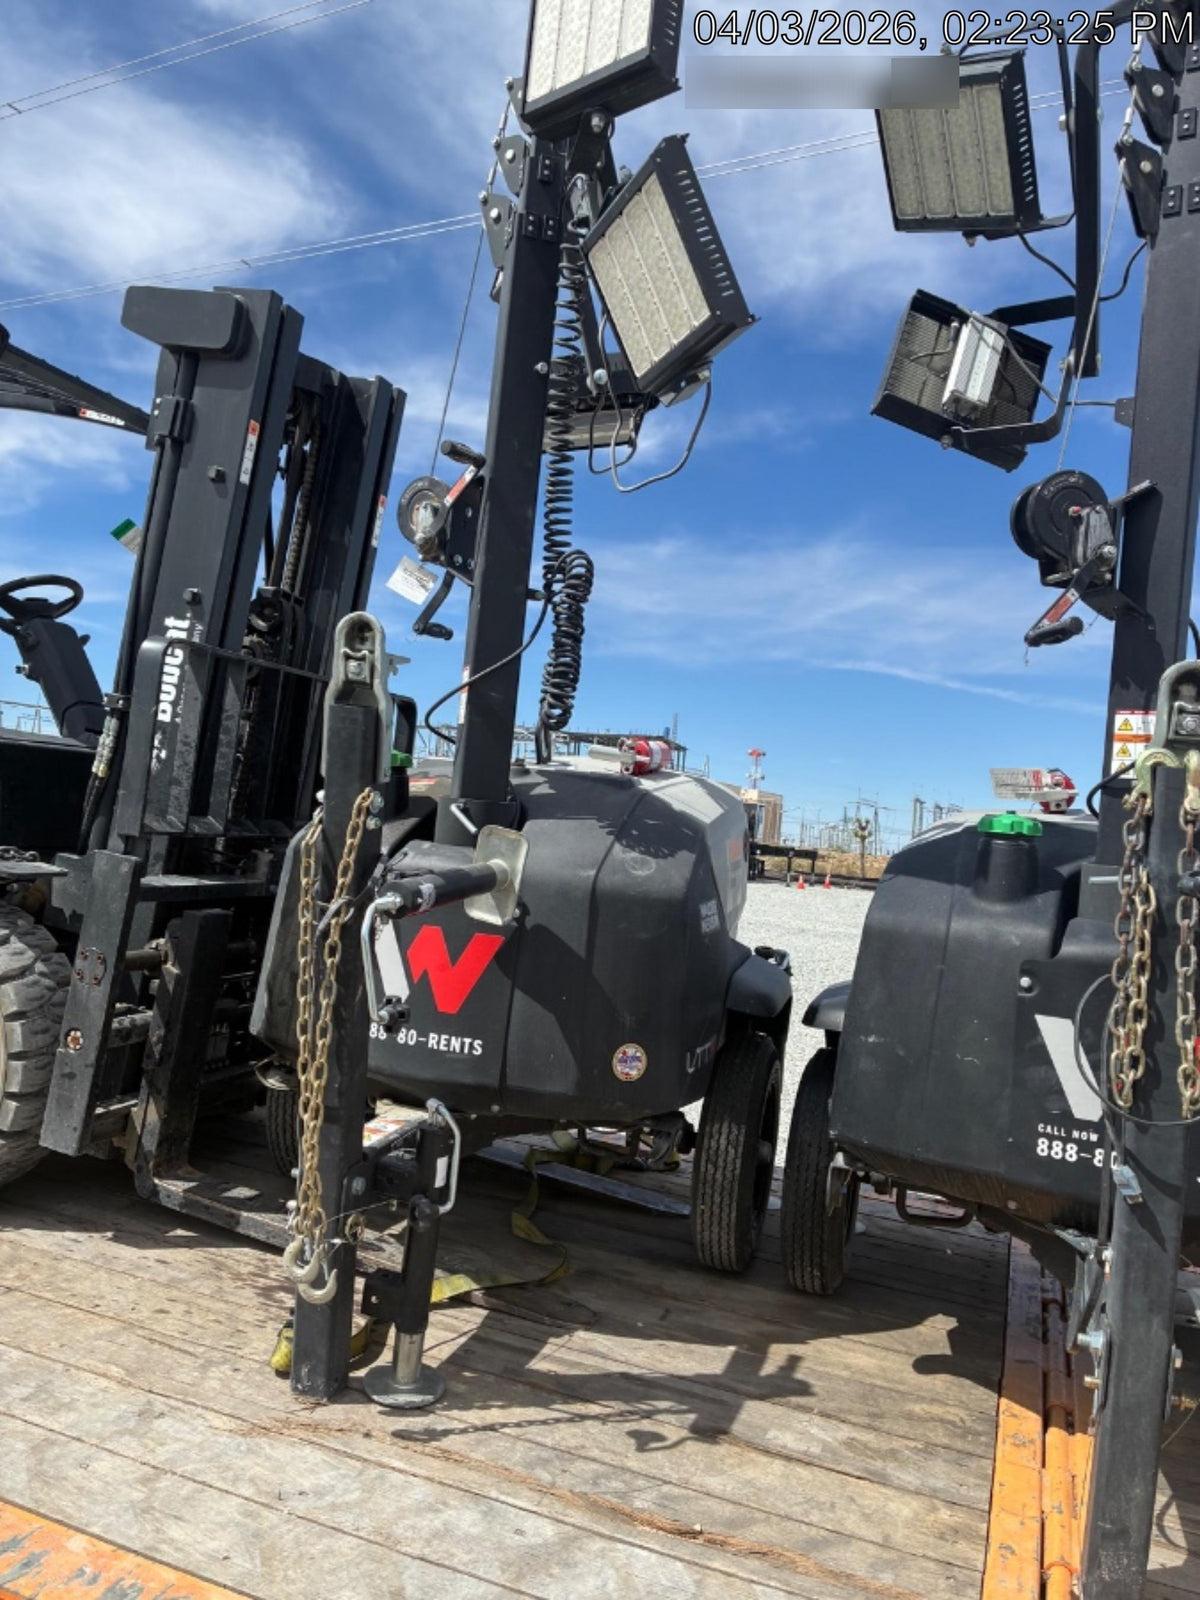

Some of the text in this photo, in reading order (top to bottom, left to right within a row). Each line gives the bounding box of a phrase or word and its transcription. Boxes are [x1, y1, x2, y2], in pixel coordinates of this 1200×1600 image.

[369, 1022, 483, 1056] 8880-RENTS
[1037, 1123, 1099, 1142] CALL NOW
